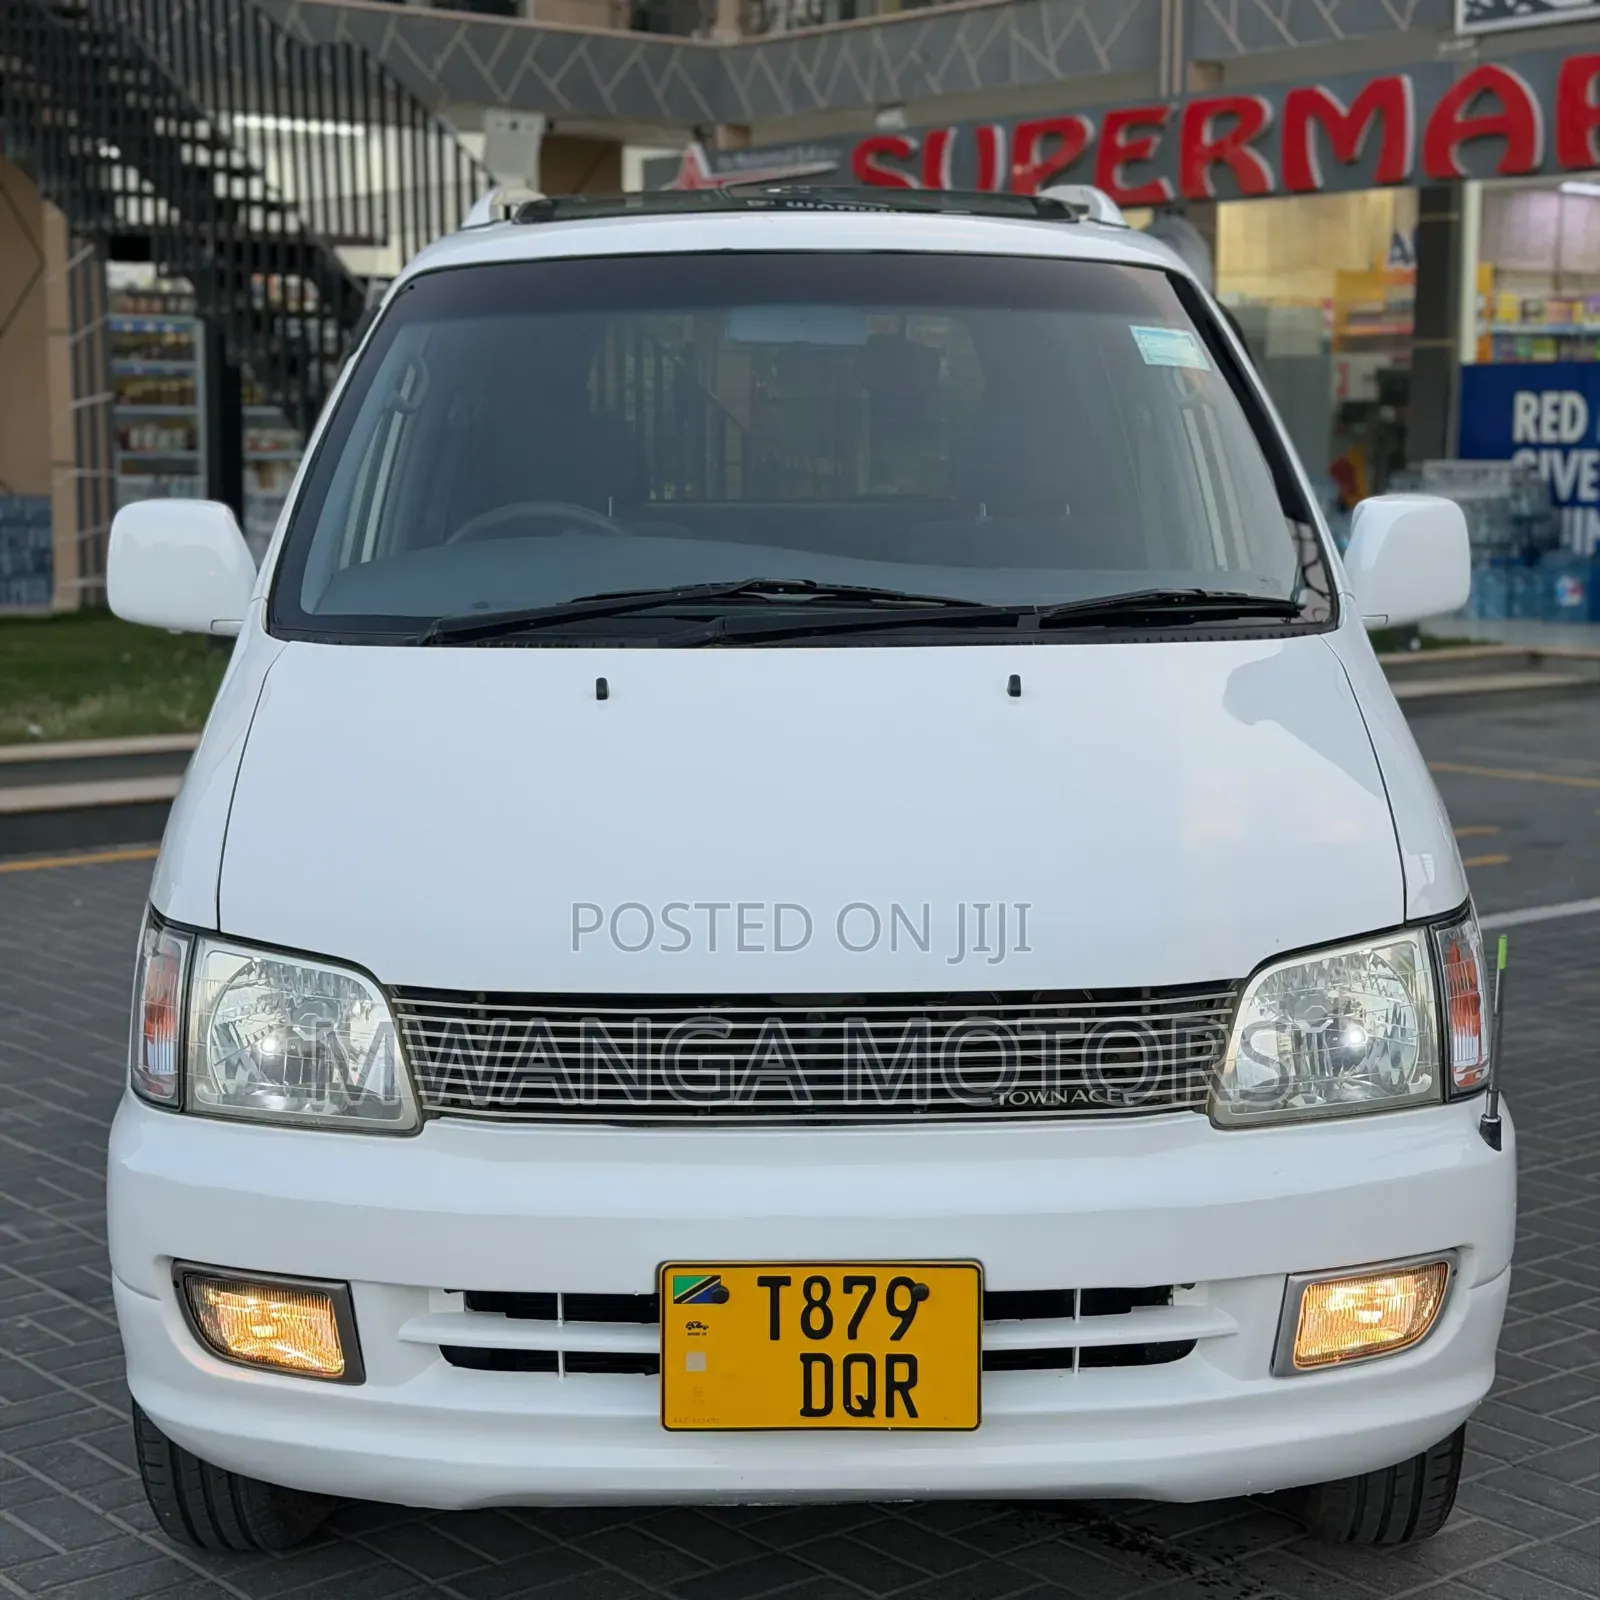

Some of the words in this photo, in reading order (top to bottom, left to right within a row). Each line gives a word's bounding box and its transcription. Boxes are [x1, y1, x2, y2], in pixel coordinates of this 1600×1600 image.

[1513, 390, 1588, 443] RED
[757, 1275, 922, 1341] T879
[799, 1353, 919, 1418] DQR
